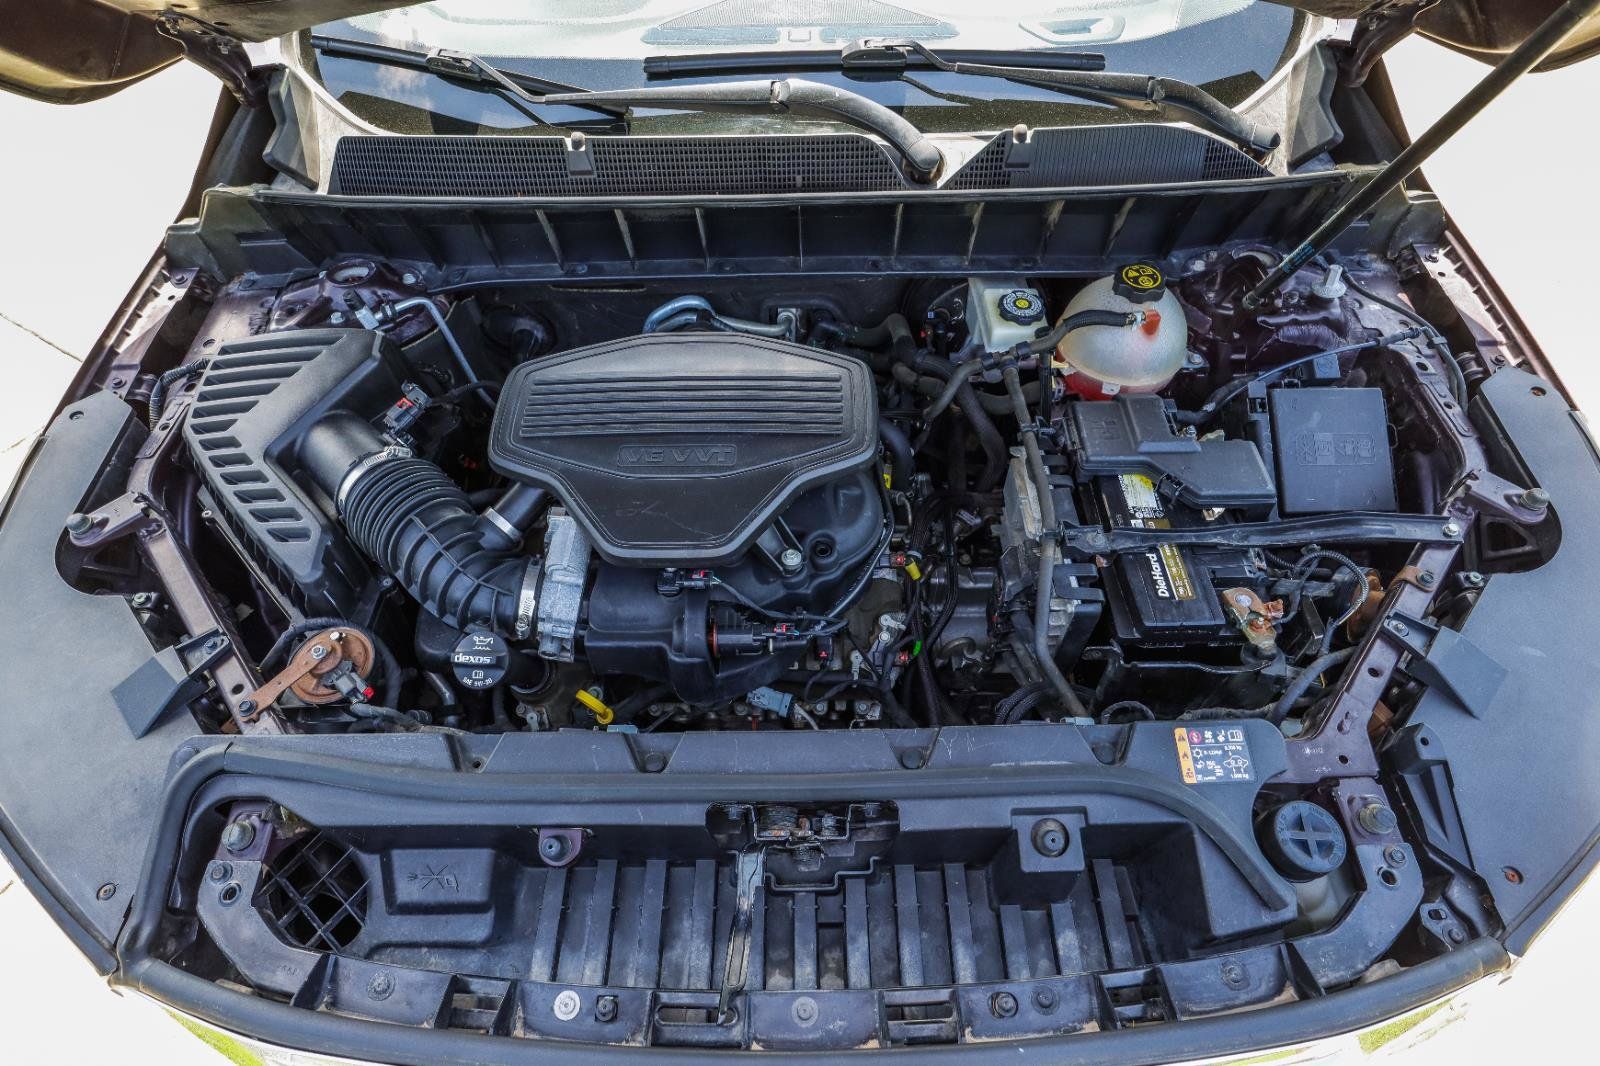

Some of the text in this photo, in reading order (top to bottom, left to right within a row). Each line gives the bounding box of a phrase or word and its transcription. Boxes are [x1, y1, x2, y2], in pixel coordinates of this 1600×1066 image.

[620, 446, 735, 463] V6 VVT
[1146, 553, 1169, 597] DieHard
[454, 652, 492, 664] dexos
[463, 677, 473, 685] SAE
